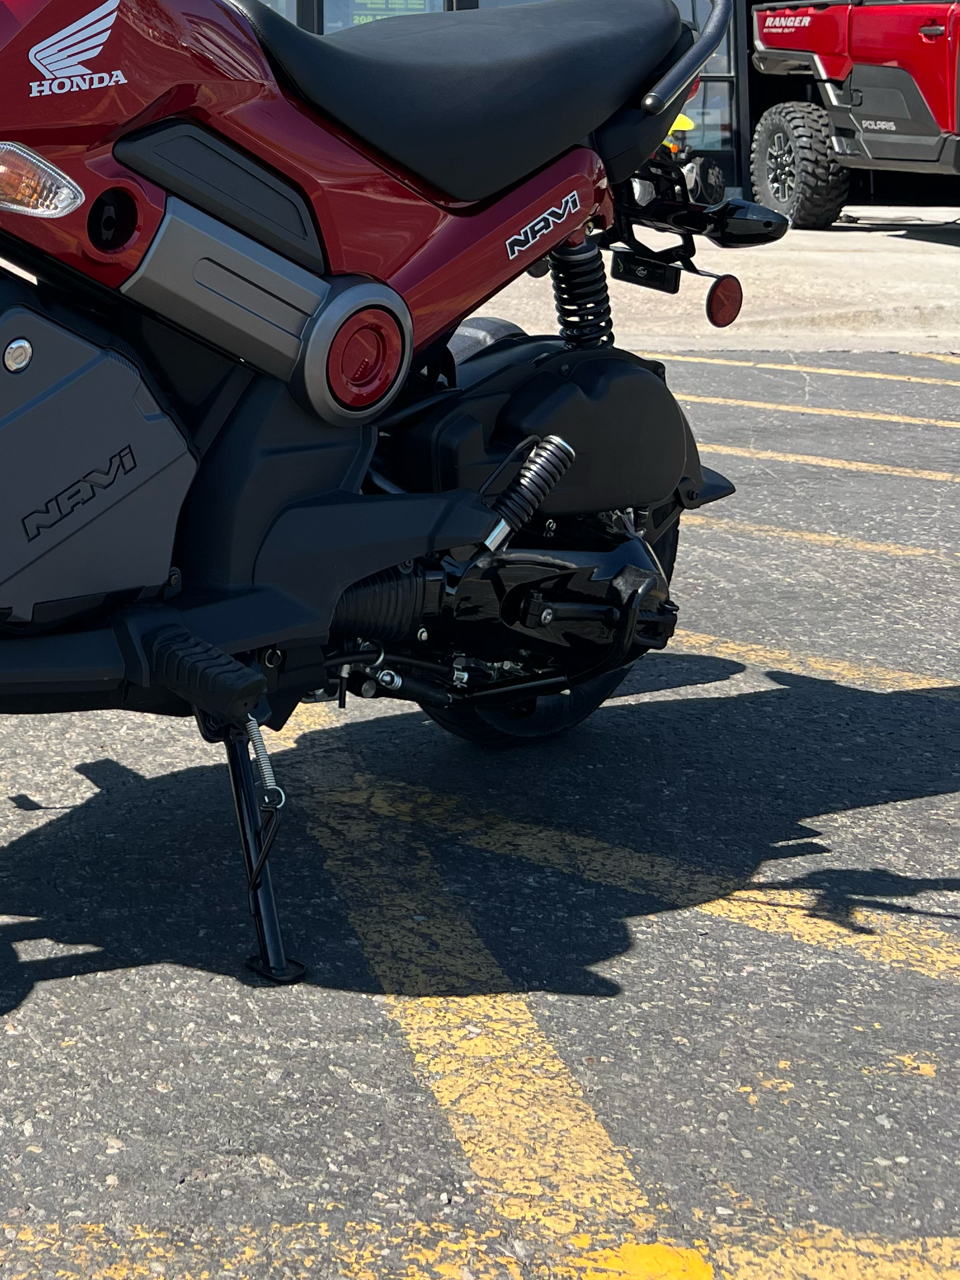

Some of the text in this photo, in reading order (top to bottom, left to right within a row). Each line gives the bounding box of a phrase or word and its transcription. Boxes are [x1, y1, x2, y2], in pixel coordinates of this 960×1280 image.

[765, 16, 811, 26] RANGER
[29, 70, 128, 97] HONDA
[862, 120, 896, 131] POLARIS
